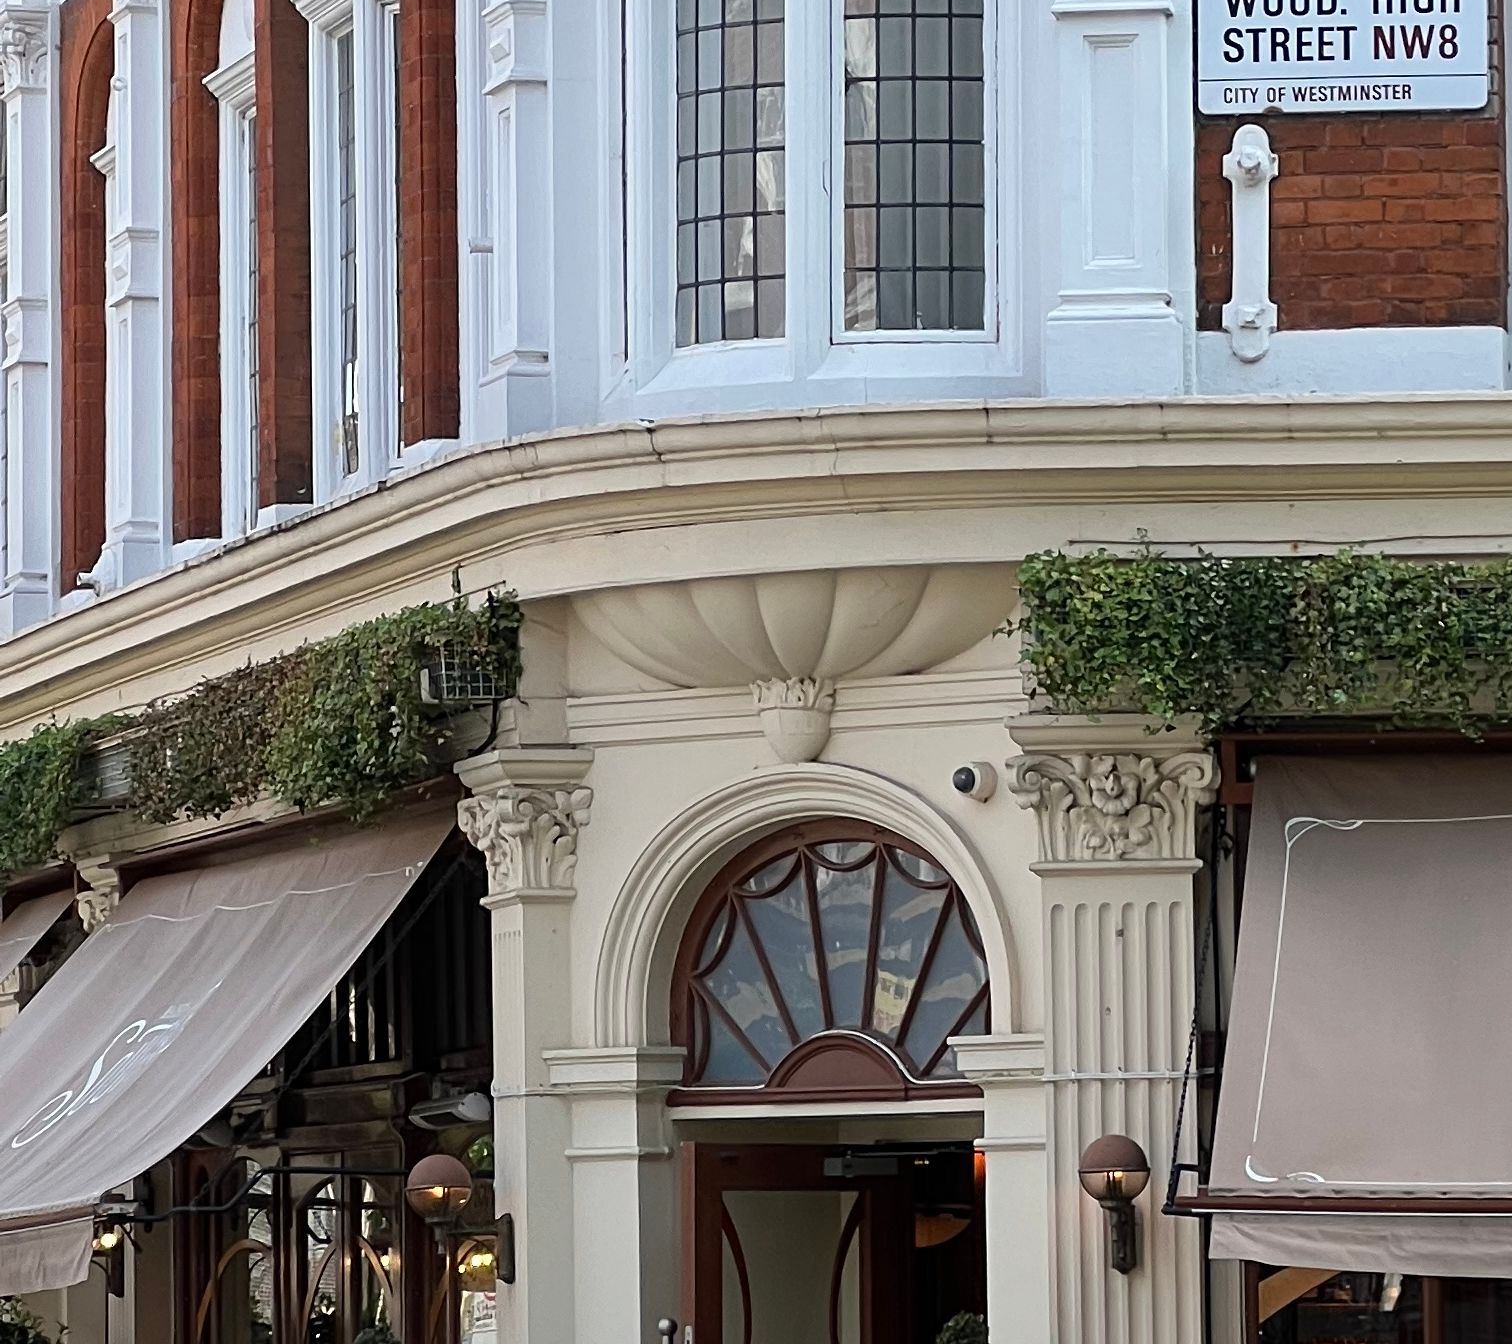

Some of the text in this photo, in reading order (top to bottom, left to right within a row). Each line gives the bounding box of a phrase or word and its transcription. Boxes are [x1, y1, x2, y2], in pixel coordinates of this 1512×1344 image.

[1223, 24, 1459, 63] STREET NW8
[1223, 83, 1412, 104] CITY OF WESTMINSTER
